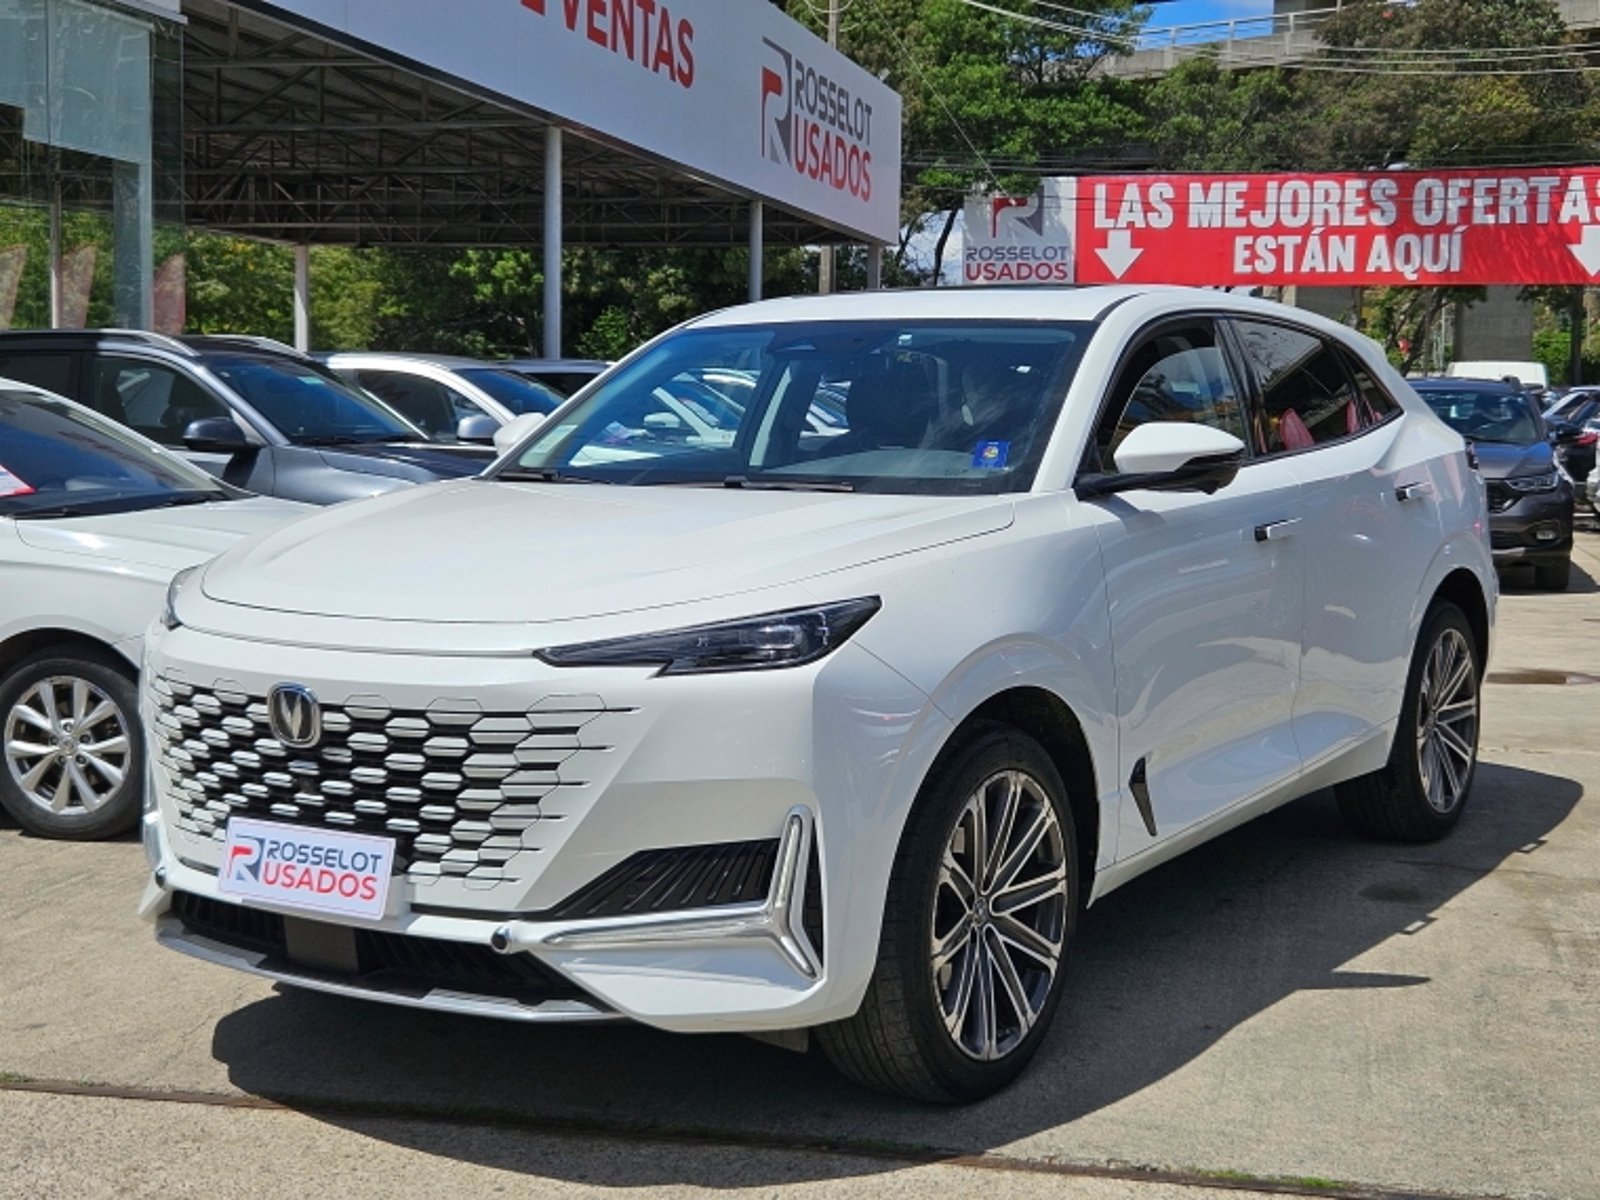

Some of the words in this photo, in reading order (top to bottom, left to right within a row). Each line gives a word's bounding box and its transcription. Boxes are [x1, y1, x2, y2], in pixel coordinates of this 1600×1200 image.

[795, 58, 872, 146] ROSSELOT
[794, 113, 871, 202] USADOS
[1094, 182, 1175, 229] LAS
[1188, 179, 1398, 227] MEJORES
[1412, 176, 1600, 226] OFERTA
[965, 262, 1068, 281] USADOS
[966, 246, 1068, 261] ROSSELOT
[1233, 227, 1355, 274] ESTÁN
[1366, 225, 1469, 281] AQUÍ
[266, 839, 383, 875] ROSSELOT
[262, 862, 378, 901] USADOS
